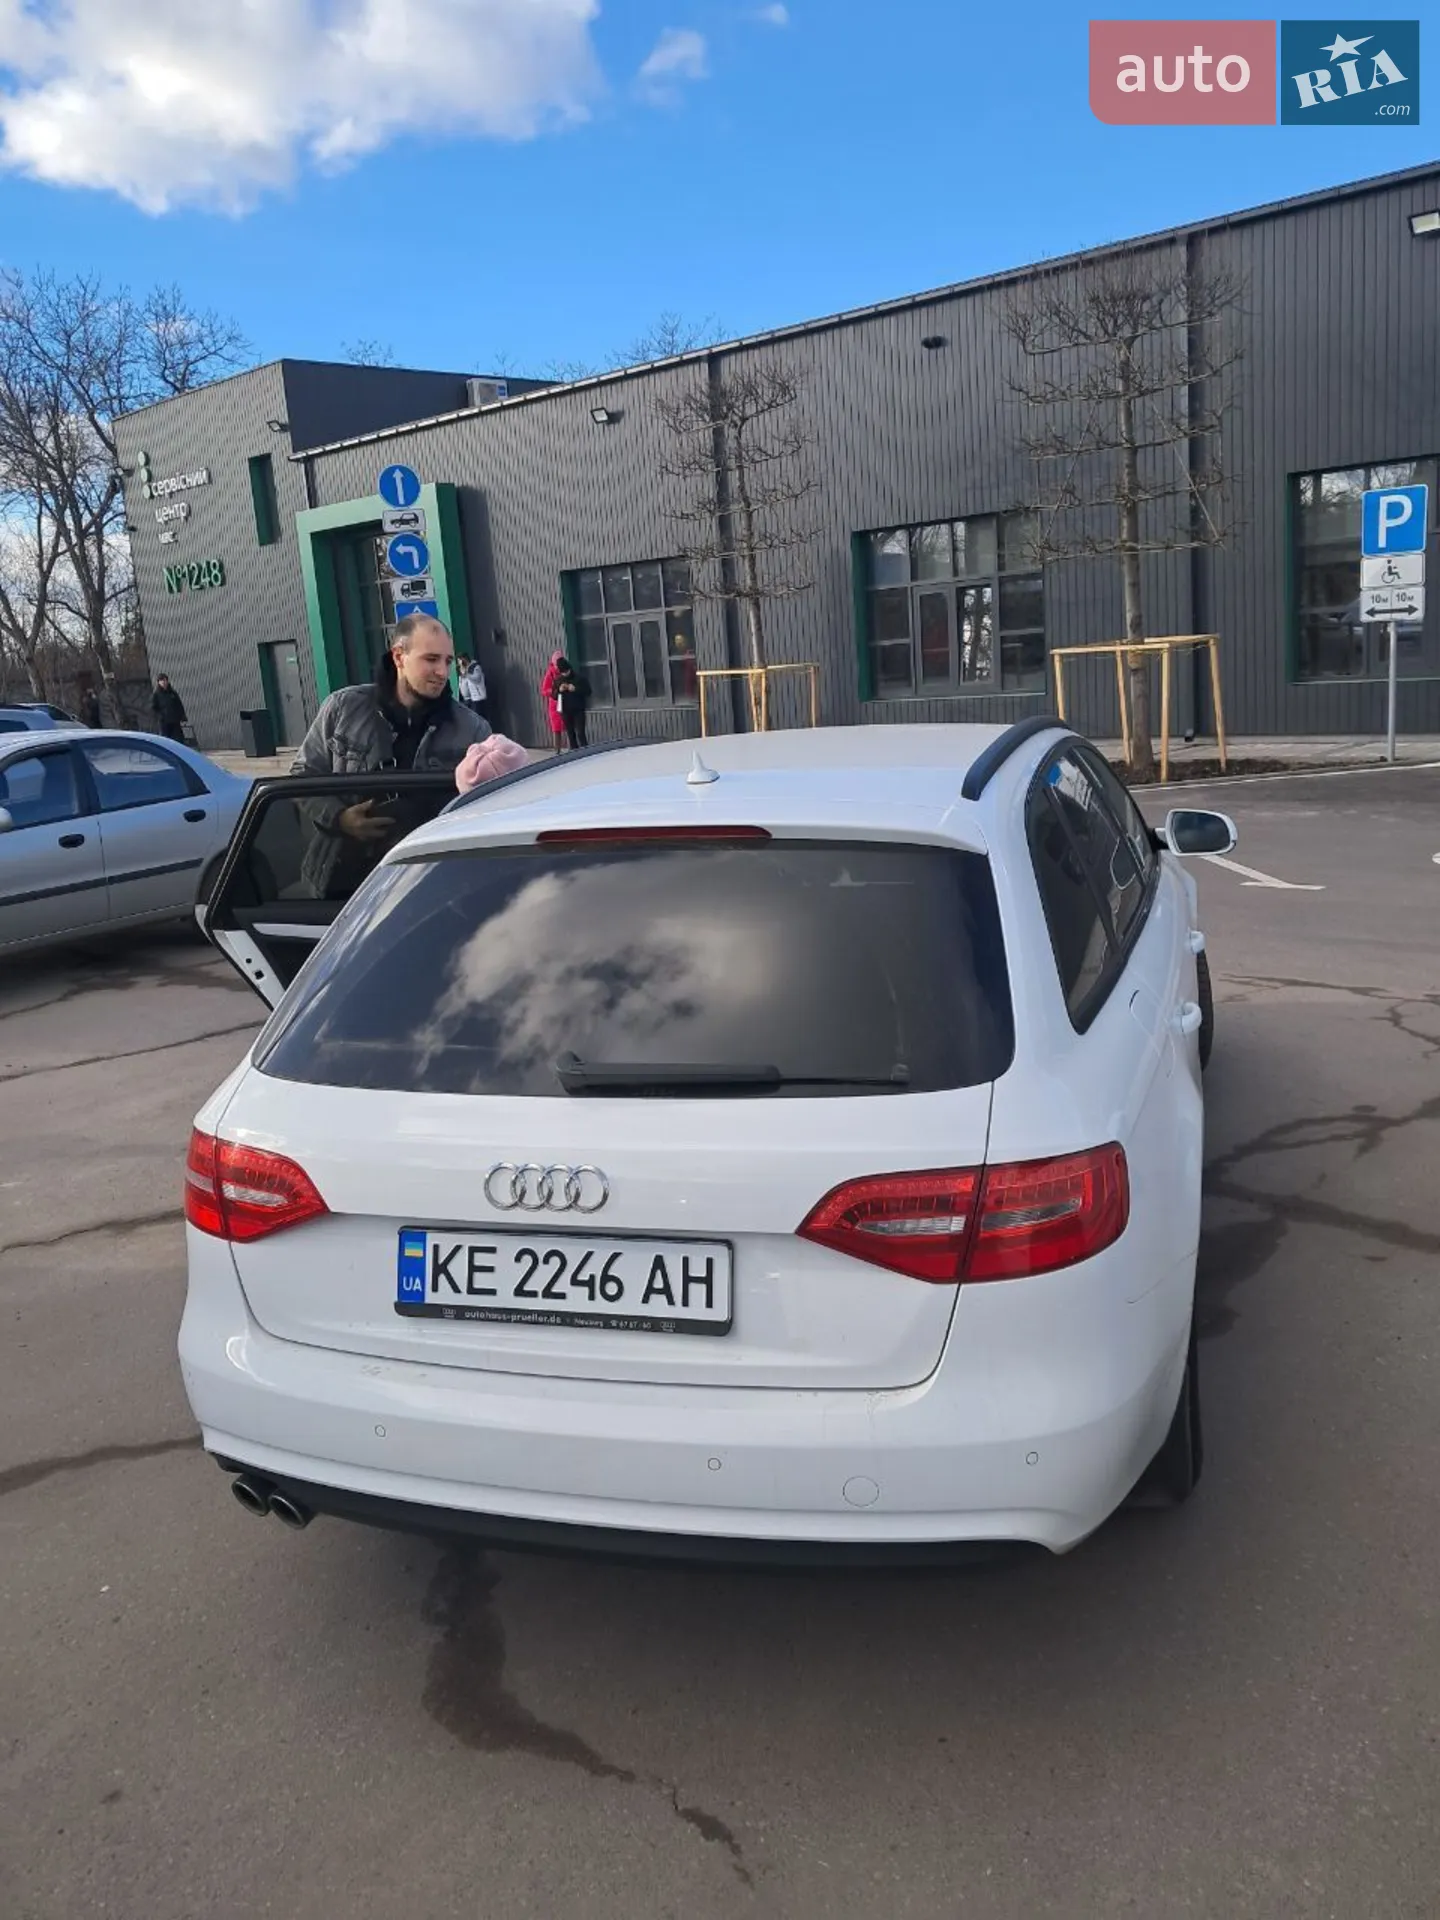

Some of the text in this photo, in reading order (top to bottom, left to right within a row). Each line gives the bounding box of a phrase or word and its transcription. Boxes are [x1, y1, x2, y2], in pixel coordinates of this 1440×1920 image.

[151, 467, 209, 498] сервісний
[155, 502, 188, 524] центр
[1378, 494, 1413, 548] P
[402, 1276, 423, 1293] UA
[430, 1242, 715, 1309] KE 2246 AH
